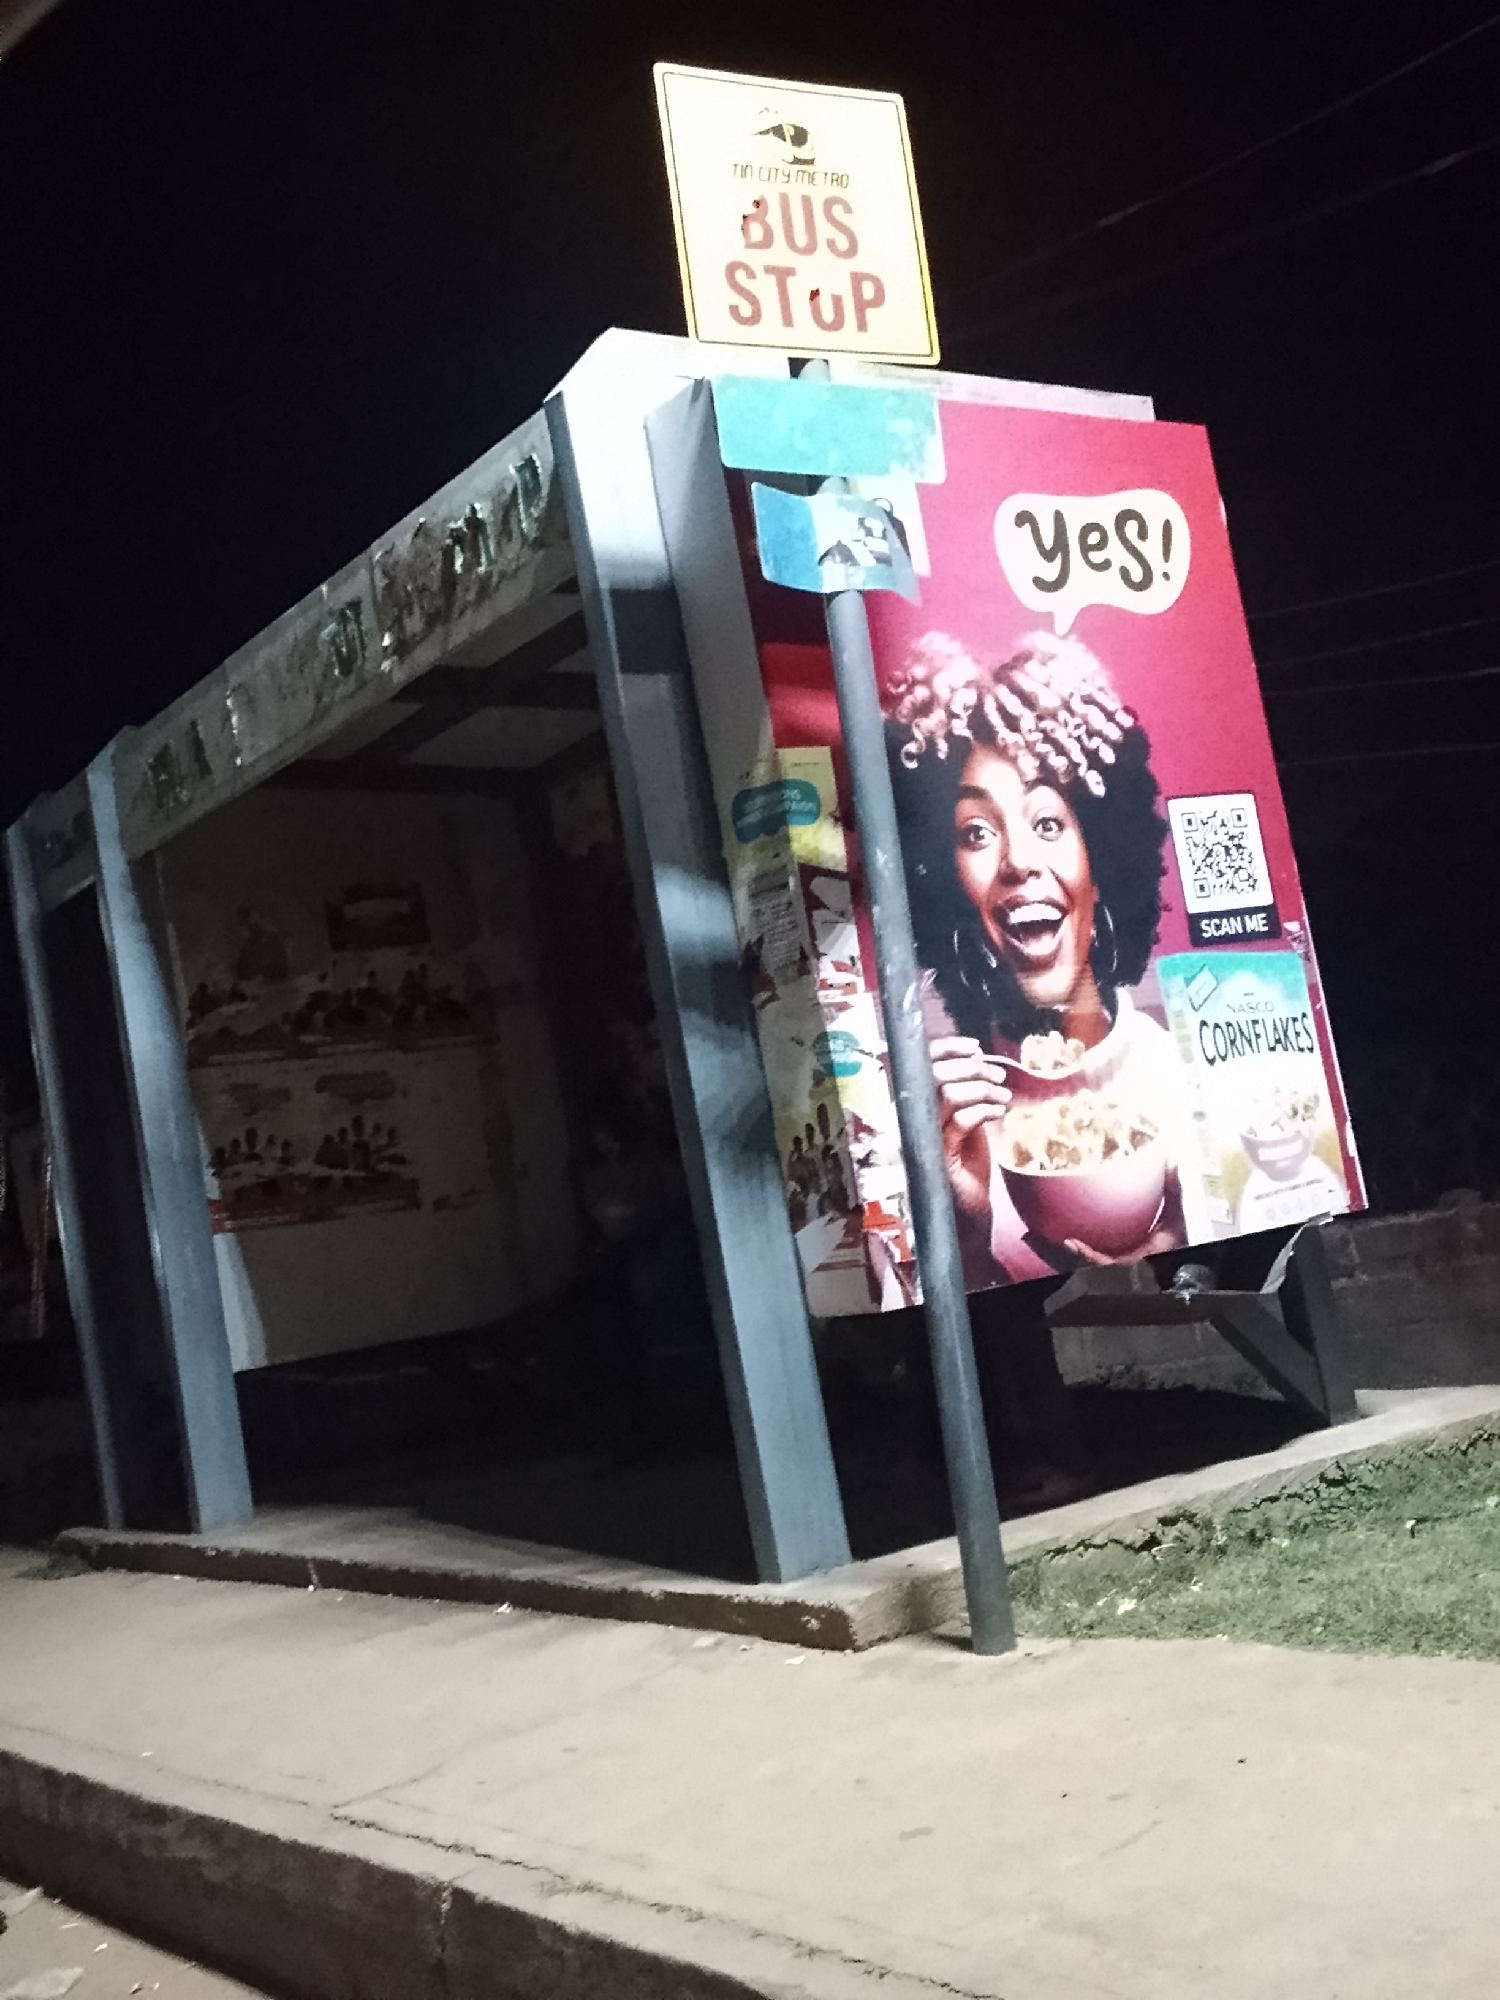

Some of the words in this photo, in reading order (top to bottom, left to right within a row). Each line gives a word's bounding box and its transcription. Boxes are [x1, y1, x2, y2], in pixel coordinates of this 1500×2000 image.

[733, 163, 753, 181] TIN
[758, 166, 791, 185] CITY
[795, 169, 850, 190] METRO
[741, 192, 859, 260] BUS
[1200, 915, 1243, 938] SCAN
[1244, 913, 1269, 932] ME
[1199, 1012, 1315, 1067] CORNFLAKES
